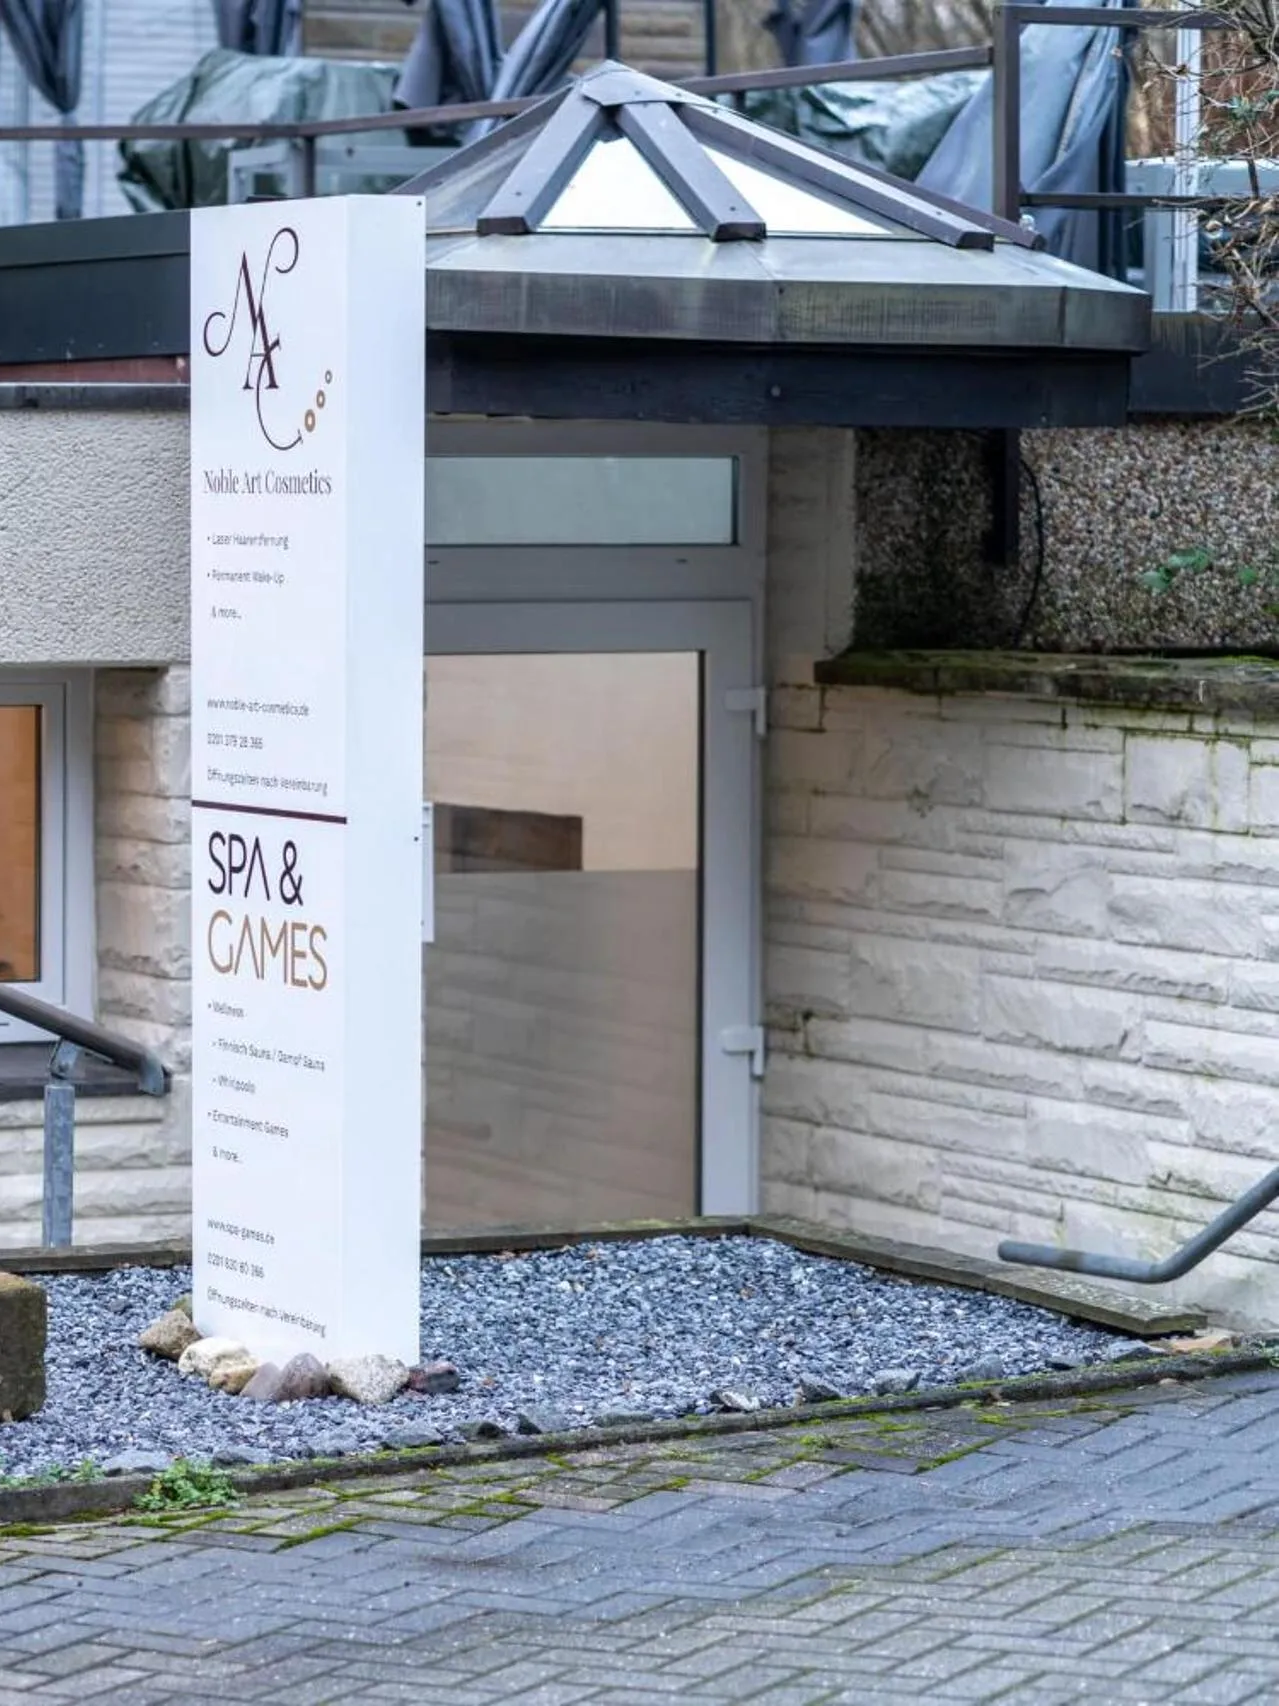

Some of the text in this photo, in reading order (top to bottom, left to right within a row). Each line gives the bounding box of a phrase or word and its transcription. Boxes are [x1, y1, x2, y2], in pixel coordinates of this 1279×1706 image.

[203, 468, 332, 495] Noble Art Cosmetics
[212, 534, 232, 546] Laser
[212, 569, 251, 582] Permanent
[208, 831, 303, 906] SPA &
[208, 909, 328, 991] GAMES
